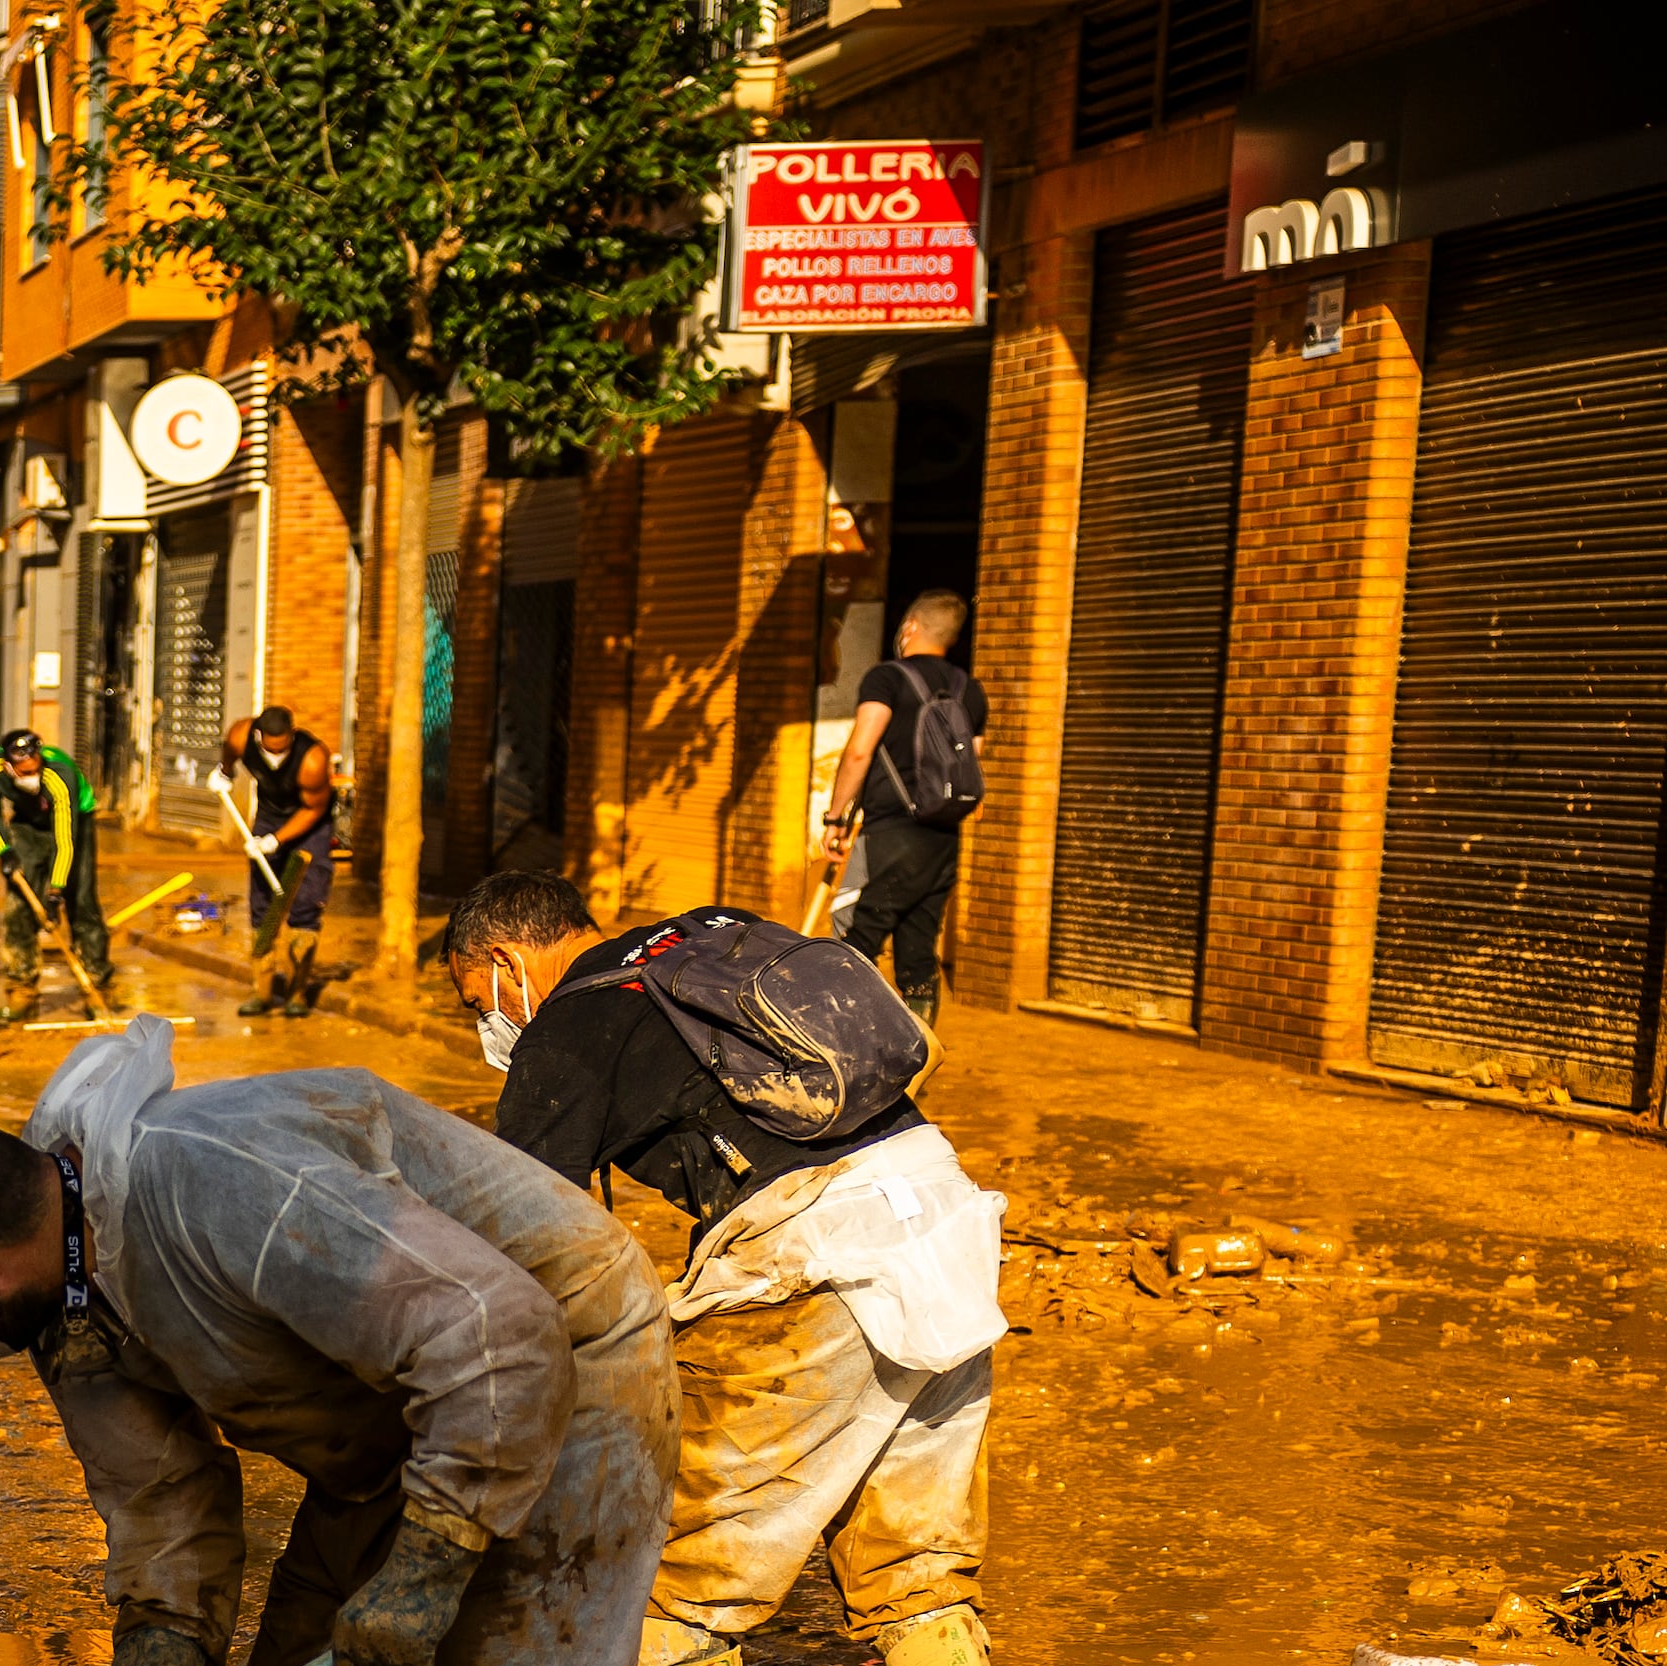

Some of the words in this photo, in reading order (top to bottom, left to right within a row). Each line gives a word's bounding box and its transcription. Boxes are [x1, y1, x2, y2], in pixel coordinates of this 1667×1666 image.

[748, 152, 980, 183] POLLERIA
[798, 187, 920, 223] VIVÓ
[745, 229, 891, 251] ESPECIALISTAS
[894, 228, 923, 248] EN
[928, 228, 978, 247] AVES
[761, 256, 843, 278] POLLOS
[846, 254, 954, 277] RELLENOS
[754, 285, 809, 305] CAZA
[810, 283, 855, 305] POR
[859, 281, 958, 304] ENCARGO
[741, 306, 888, 323] ELABORACIÓN
[890, 305, 972, 321] PROPIA
[167, 409, 202, 451] C
